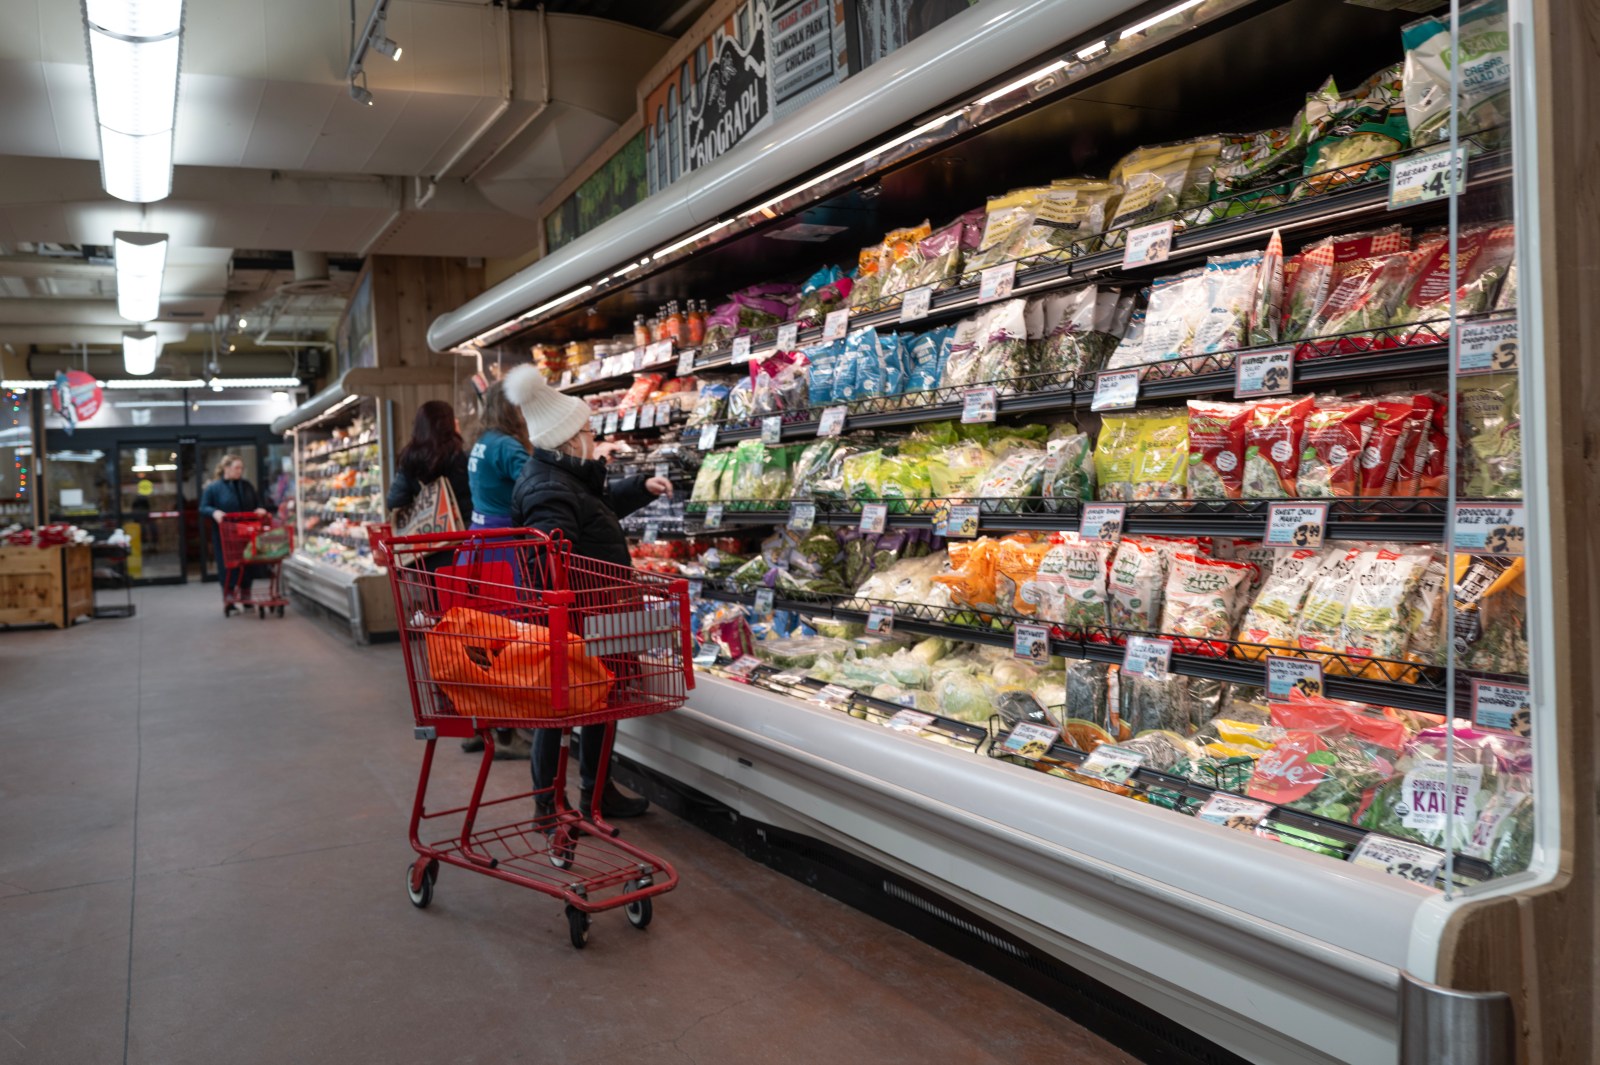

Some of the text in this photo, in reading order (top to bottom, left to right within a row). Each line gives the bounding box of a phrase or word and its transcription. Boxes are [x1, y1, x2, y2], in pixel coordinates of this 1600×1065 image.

[776, 15, 823, 57] LINCOLN PARK
[785, 43, 816, 73] CHICAGO
[1463, 56, 1504, 77] CAESAR
[1463, 70, 1495, 87] SALAD
[696, 77, 760, 169] BIOGRAPH
[1463, 323, 1518, 336] DILL-ICIOU
[1270, 354, 1289, 362] APPLE
[1491, 342, 1518, 369] $3.
[1274, 508, 1296, 516] SWEET
[1457, 508, 1501, 517] BROCCOLI
[1457, 516, 1481, 524] KALE
[1187, 569, 1229, 584] PIZZA
[1412, 780, 1469, 795] SHREDED
[1412, 790, 1468, 816] KALE
[1363, 850, 1394, 862] KALE
